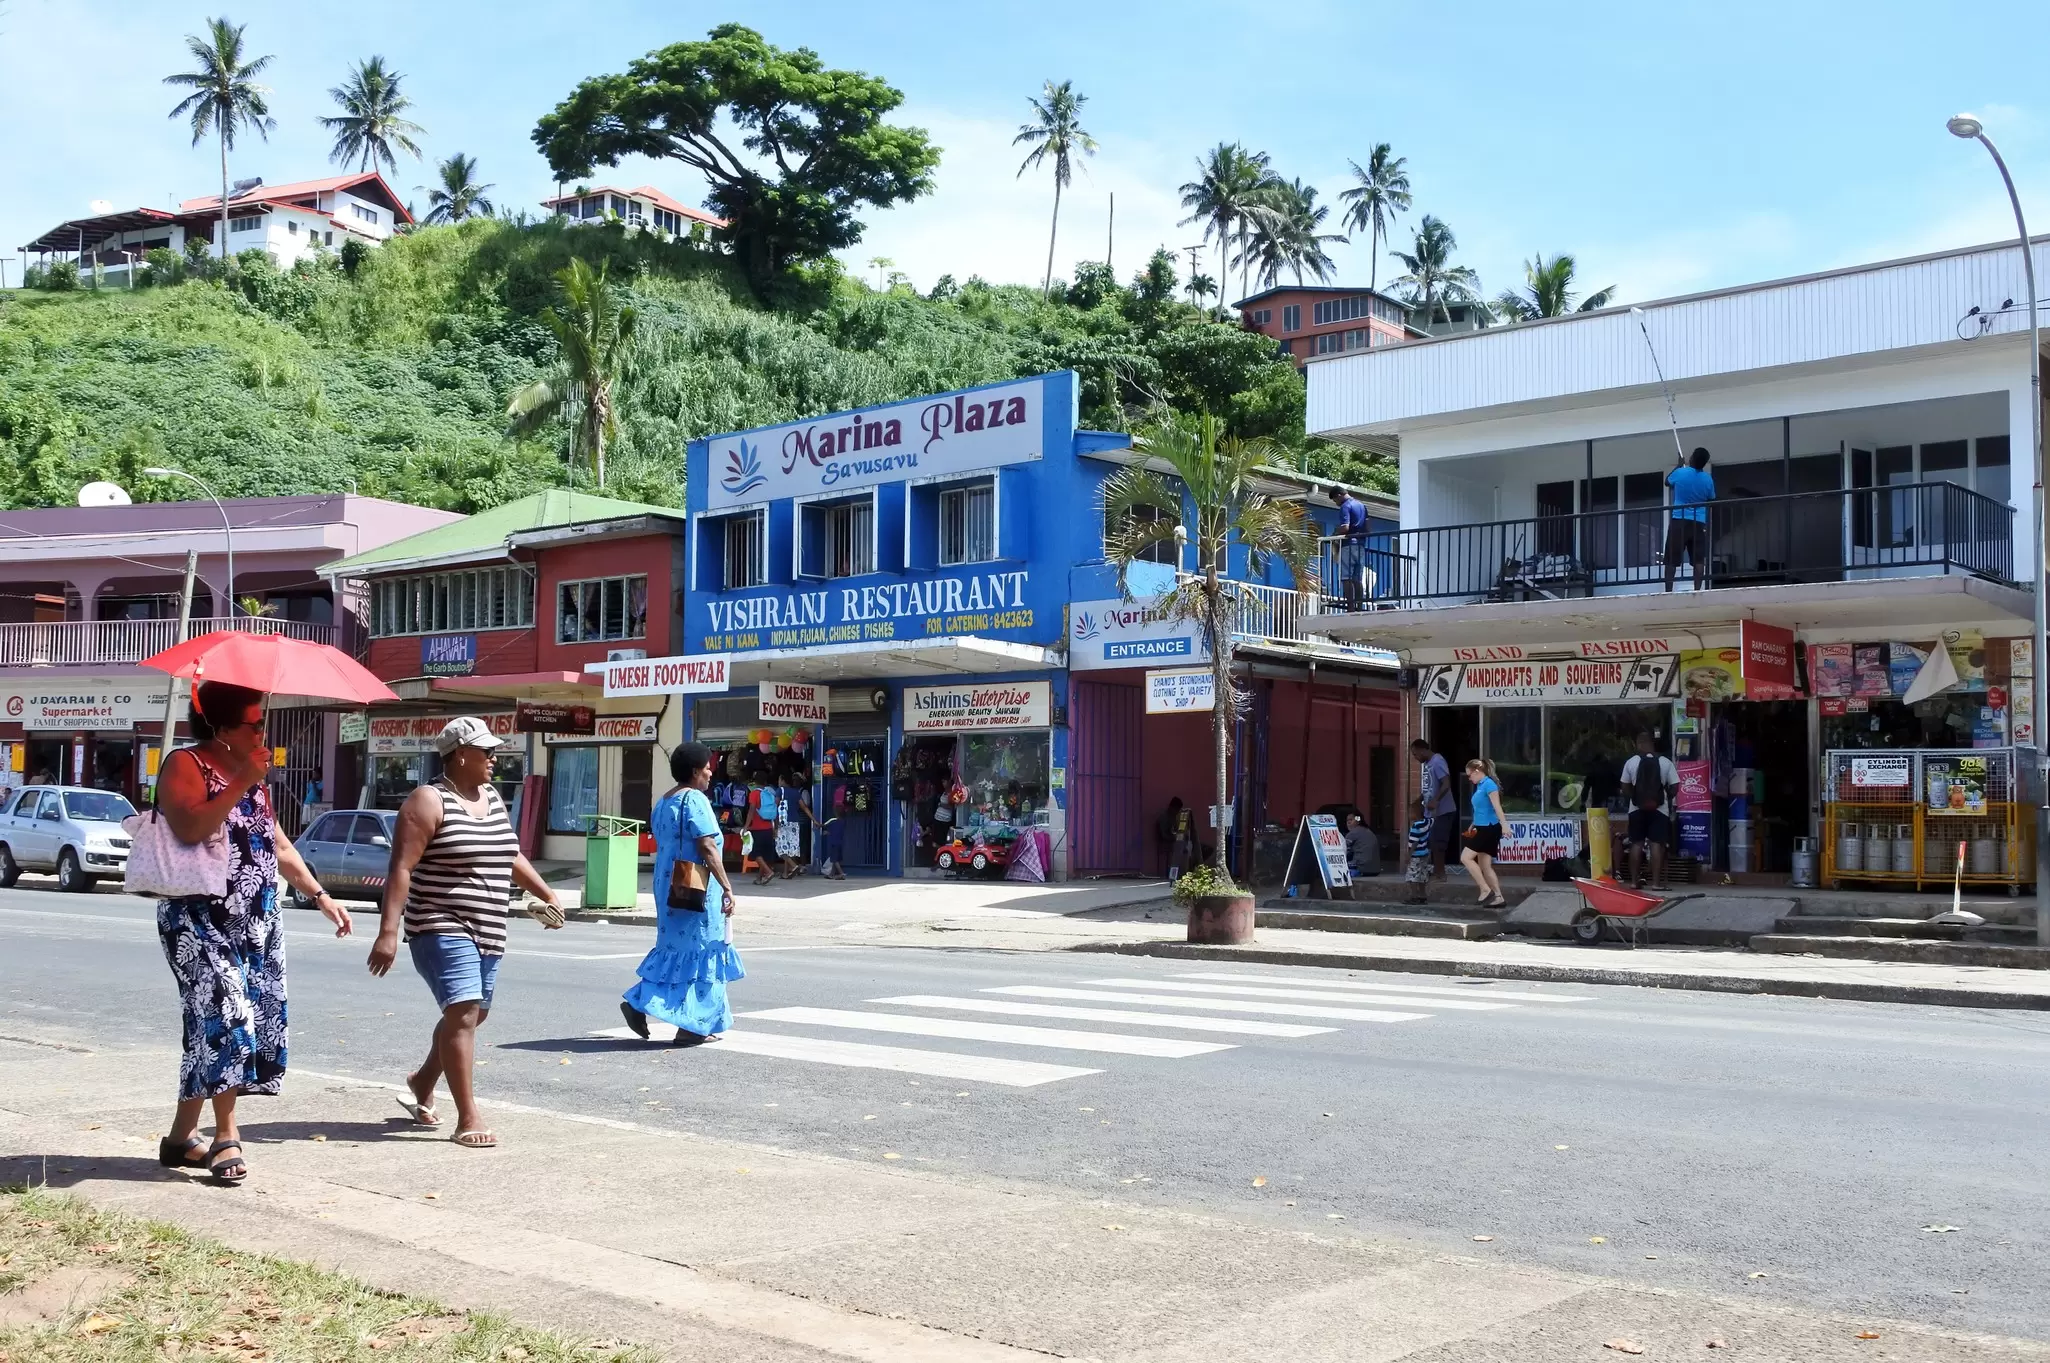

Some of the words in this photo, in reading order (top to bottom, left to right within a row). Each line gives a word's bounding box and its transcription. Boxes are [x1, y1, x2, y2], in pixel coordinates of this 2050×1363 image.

[782, 414, 901, 475] Marina
[921, 396, 1026, 454] Plaza
[821, 452, 918, 485] Savusavu
[707, 591, 828, 632] VISHRANJ
[841, 571, 1029, 621] RESTAURANT
[864, 622, 895, 639] DISHES
[926, 617, 943, 634] FOR
[428, 637, 468, 661] AHAVAH
[704, 636, 722, 650] VALE
[725, 634, 734, 649] NI
[737, 632, 760, 648] KANA
[1110, 641, 1185, 657] ENTRANCE
[1453, 646, 1523, 661] ISLAND
[1580, 639, 1670, 657] FASHION
[609, 666, 650, 689] UMESH
[653, 660, 725, 686] FOOTWEAR
[1466, 665, 1532, 688] HANDICRAFTS
[1538, 664, 1559, 686] AND
[1566, 663, 1622, 684] SOUVENIRS
[114, 695, 131, 704] CO
[775, 685, 815, 701] UMESH
[914, 691, 970, 710] Ashwins
[970, 687, 1031, 709] Enterprise
[1485, 687, 1546, 698] LOCALLY
[1563, 686, 1602, 696] MADE
[762, 702, 827, 720] FOOTWEAR
[1175, 697, 1189, 708] SHOP
[42, 706, 113, 718] Supermarket
[533, 715, 557, 723] KITCHEN
[541, 709, 568, 717] COUNTRY
[968, 708, 992, 716] BEAUTY
[33, 718, 61, 727] FAMILY
[64, 717, 99, 727] SHOPPING
[101, 717, 129, 727] CENTRE
[598, 719, 642, 737] KITCHEN
[1529, 823, 1573, 838] FASHION
